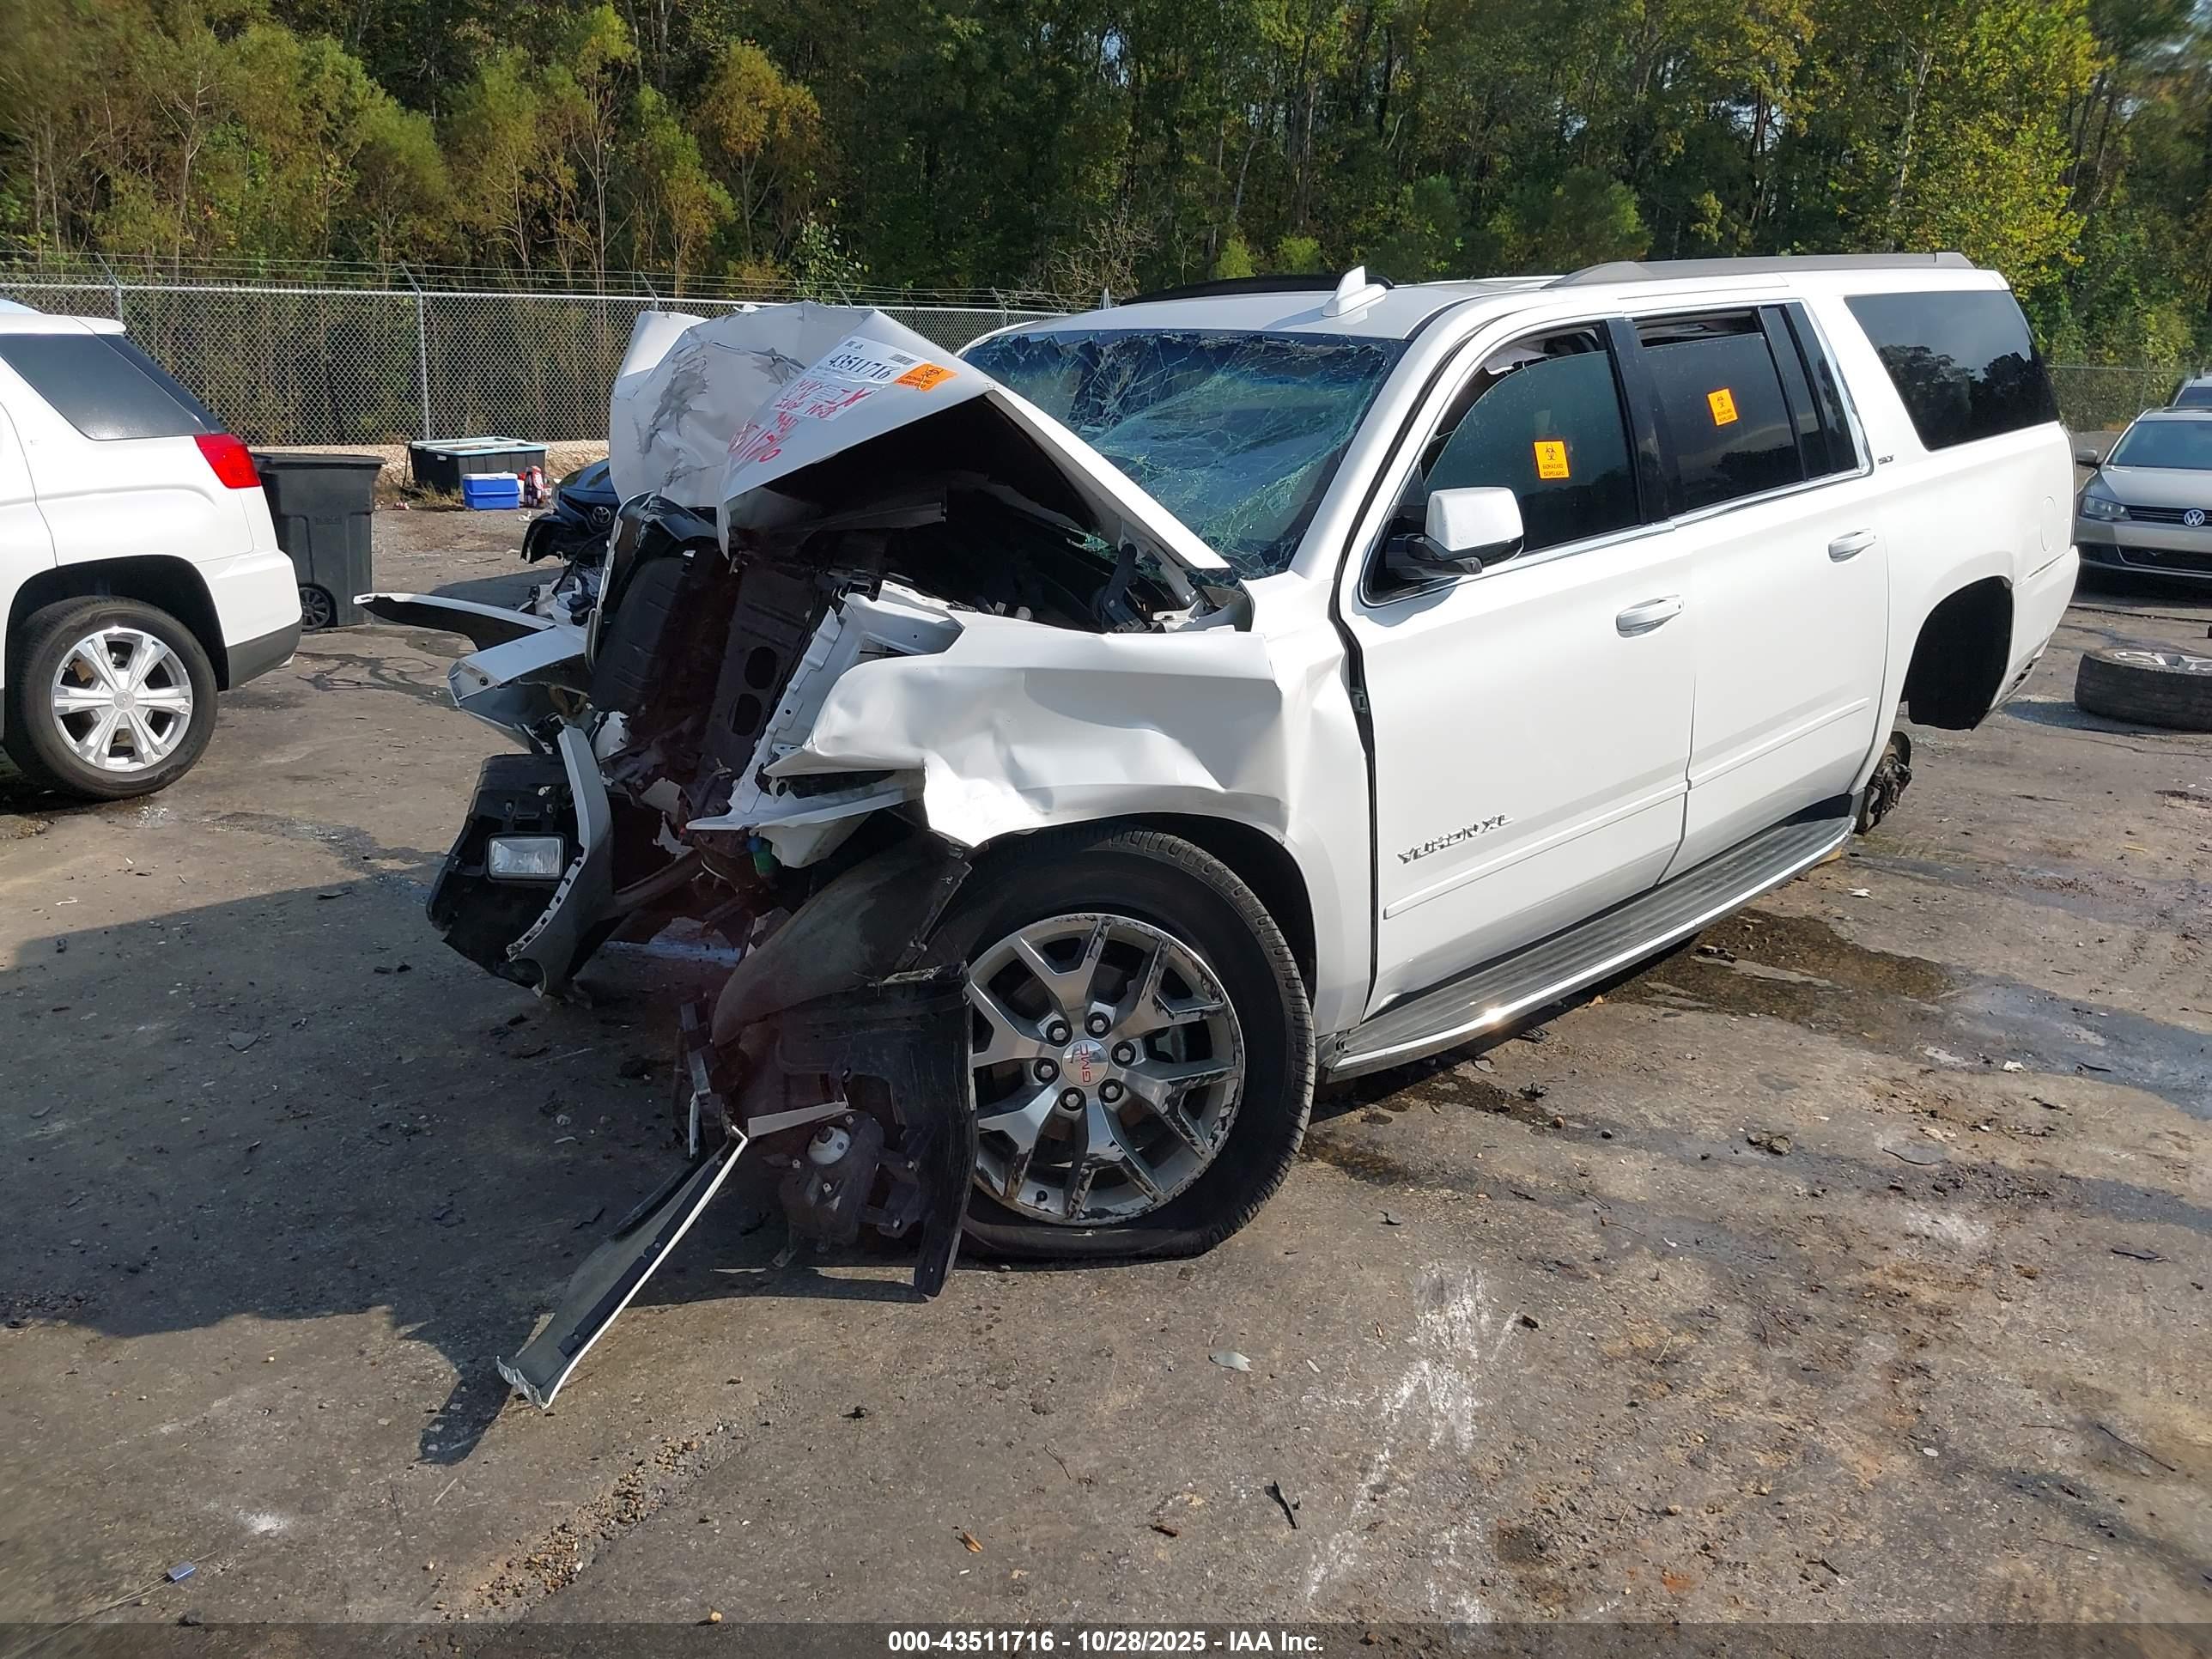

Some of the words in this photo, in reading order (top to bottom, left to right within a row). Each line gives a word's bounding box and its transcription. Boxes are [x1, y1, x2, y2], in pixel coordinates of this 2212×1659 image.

[828, 353, 893, 380] 43511716
[1396, 823, 1480, 865] YUKON
[1481, 813, 1515, 835] XL
[1079, 1043, 1091, 1083] GMC
